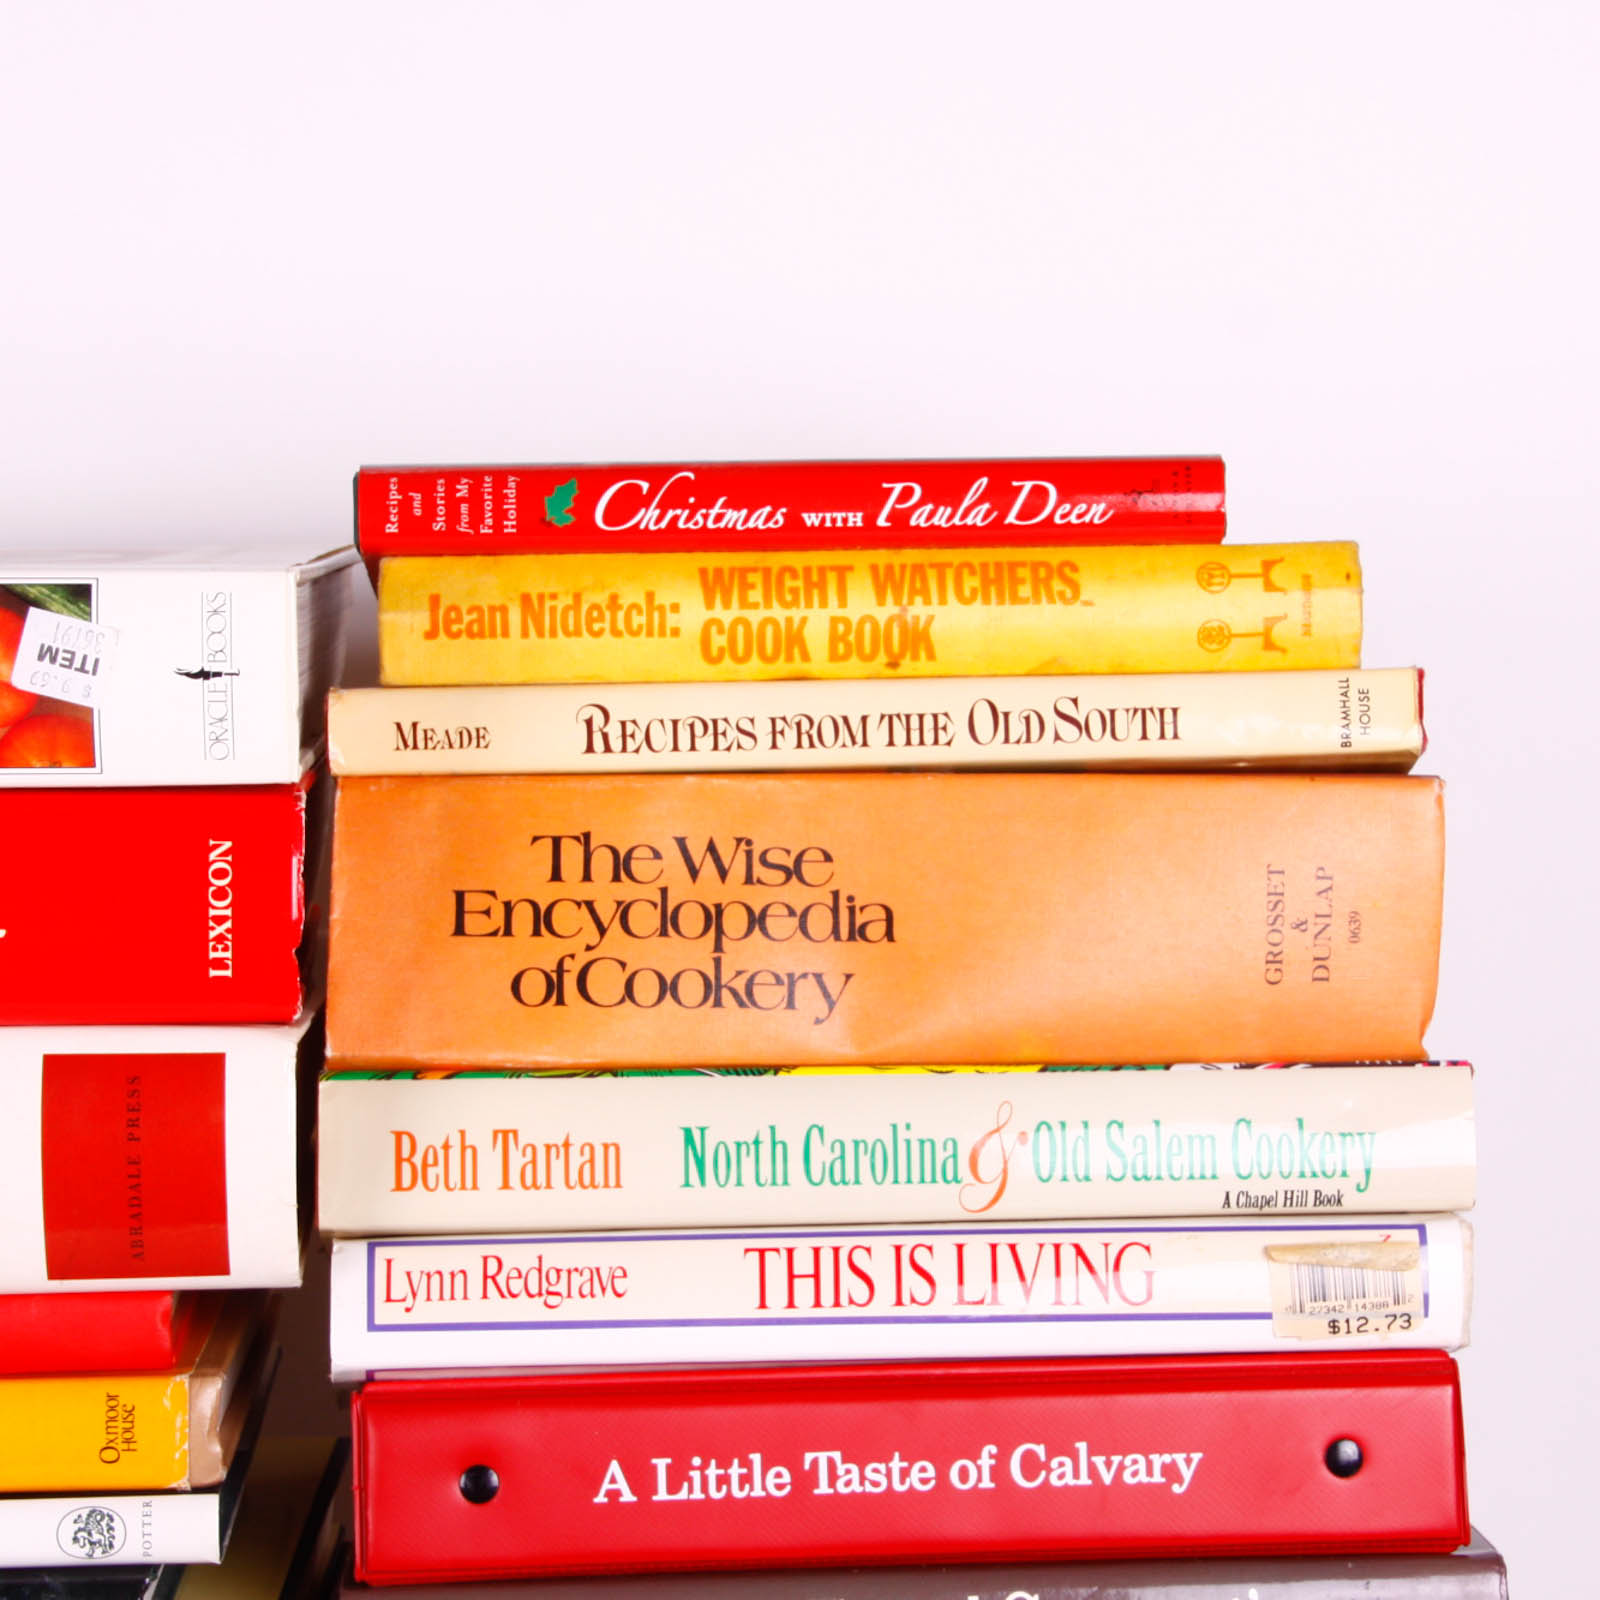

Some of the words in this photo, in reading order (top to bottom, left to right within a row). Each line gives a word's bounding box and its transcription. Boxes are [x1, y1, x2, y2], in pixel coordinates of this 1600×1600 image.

[385, 477, 402, 533] Recipes
[408, 492, 422, 516] and
[432, 478, 446, 531] Stories
[456, 477, 473, 497] My
[480, 475, 493, 534] Favorite
[503, 475, 520, 533] Holiday
[594, 471, 787, 532] Christmas
[802, 511, 864, 528] WITH
[876, 476, 998, 528] Paula
[1005, 479, 1113, 526] Deen
[456, 503, 474, 535] from
[698, 565, 854, 611] WEIGHT
[869, 560, 1081, 606] WATCHERS
[206, 591, 227, 663] BOOKS
[424, 593, 509, 640] Jean
[520, 590, 681, 639] Nidetch:
[699, 615, 812, 665] COOK
[828, 613, 937, 664] BOOK
[37, 642, 100, 676] ITEM
[207, 682, 230, 761] ORACLE
[576, 702, 758, 755] RECIPES
[767, 712, 872, 750] FROM
[876, 711, 956, 748] THE
[967, 698, 1046, 746] OLD
[1053, 696, 1182, 744] SOUTH
[1338, 676, 1352, 748] BRAMHALL
[1358, 688, 1371, 735] HOUSE
[531, 830, 664, 884] The
[672, 836, 835, 887] Wise
[208, 839, 233, 979] LEXICON
[450, 886, 896, 954] Encyclopedia
[1264, 863, 1285, 986] GROSSET
[1291, 917, 1308, 933] &
[1311, 866, 1333, 983] DUNLAP
[1348, 910, 1361, 944] 0639
[510, 953, 576, 1008] of
[576, 955, 856, 1025] Cookery
[126, 1075, 141, 1142] PRESS
[390, 1129, 480, 1193] Beth
[492, 1128, 623, 1192] Tartan
[679, 1124, 790, 1189] North
[803, 1121, 963, 1187] Carolina
[958, 1100, 1029, 1213] &
[1031, 1119, 1092, 1183] Old
[1105, 1119, 1220, 1182] Salem
[1231, 1117, 1377, 1193] Cookery
[127, 1155, 144, 1260] ABRADALE
[1222, 1191, 1231, 1209] A
[1236, 1190, 1278, 1210] Chapel
[1283, 1190, 1308, 1208] Hill
[1312, 1190, 1344, 1208] Book
[384, 1257, 469, 1312] Lynn
[480, 1254, 628, 1309] Redgrave
[744, 1244, 875, 1310] THIS
[889, 1243, 937, 1307] IS
[952, 1241, 1156, 1307] LIVING
[1328, 1313, 1412, 1335] $12.73
[99, 1391, 120, 1464] Oxmoor
[121, 1404, 137, 1452] House
[593, 1460, 637, 1503] A
[650, 1453, 792, 1501] Little
[803, 1451, 936, 1495] Taste
[949, 1445, 997, 1490] of
[1009, 1442, 1203, 1492] Calvary
[142, 1500, 152, 1558] POTTER
